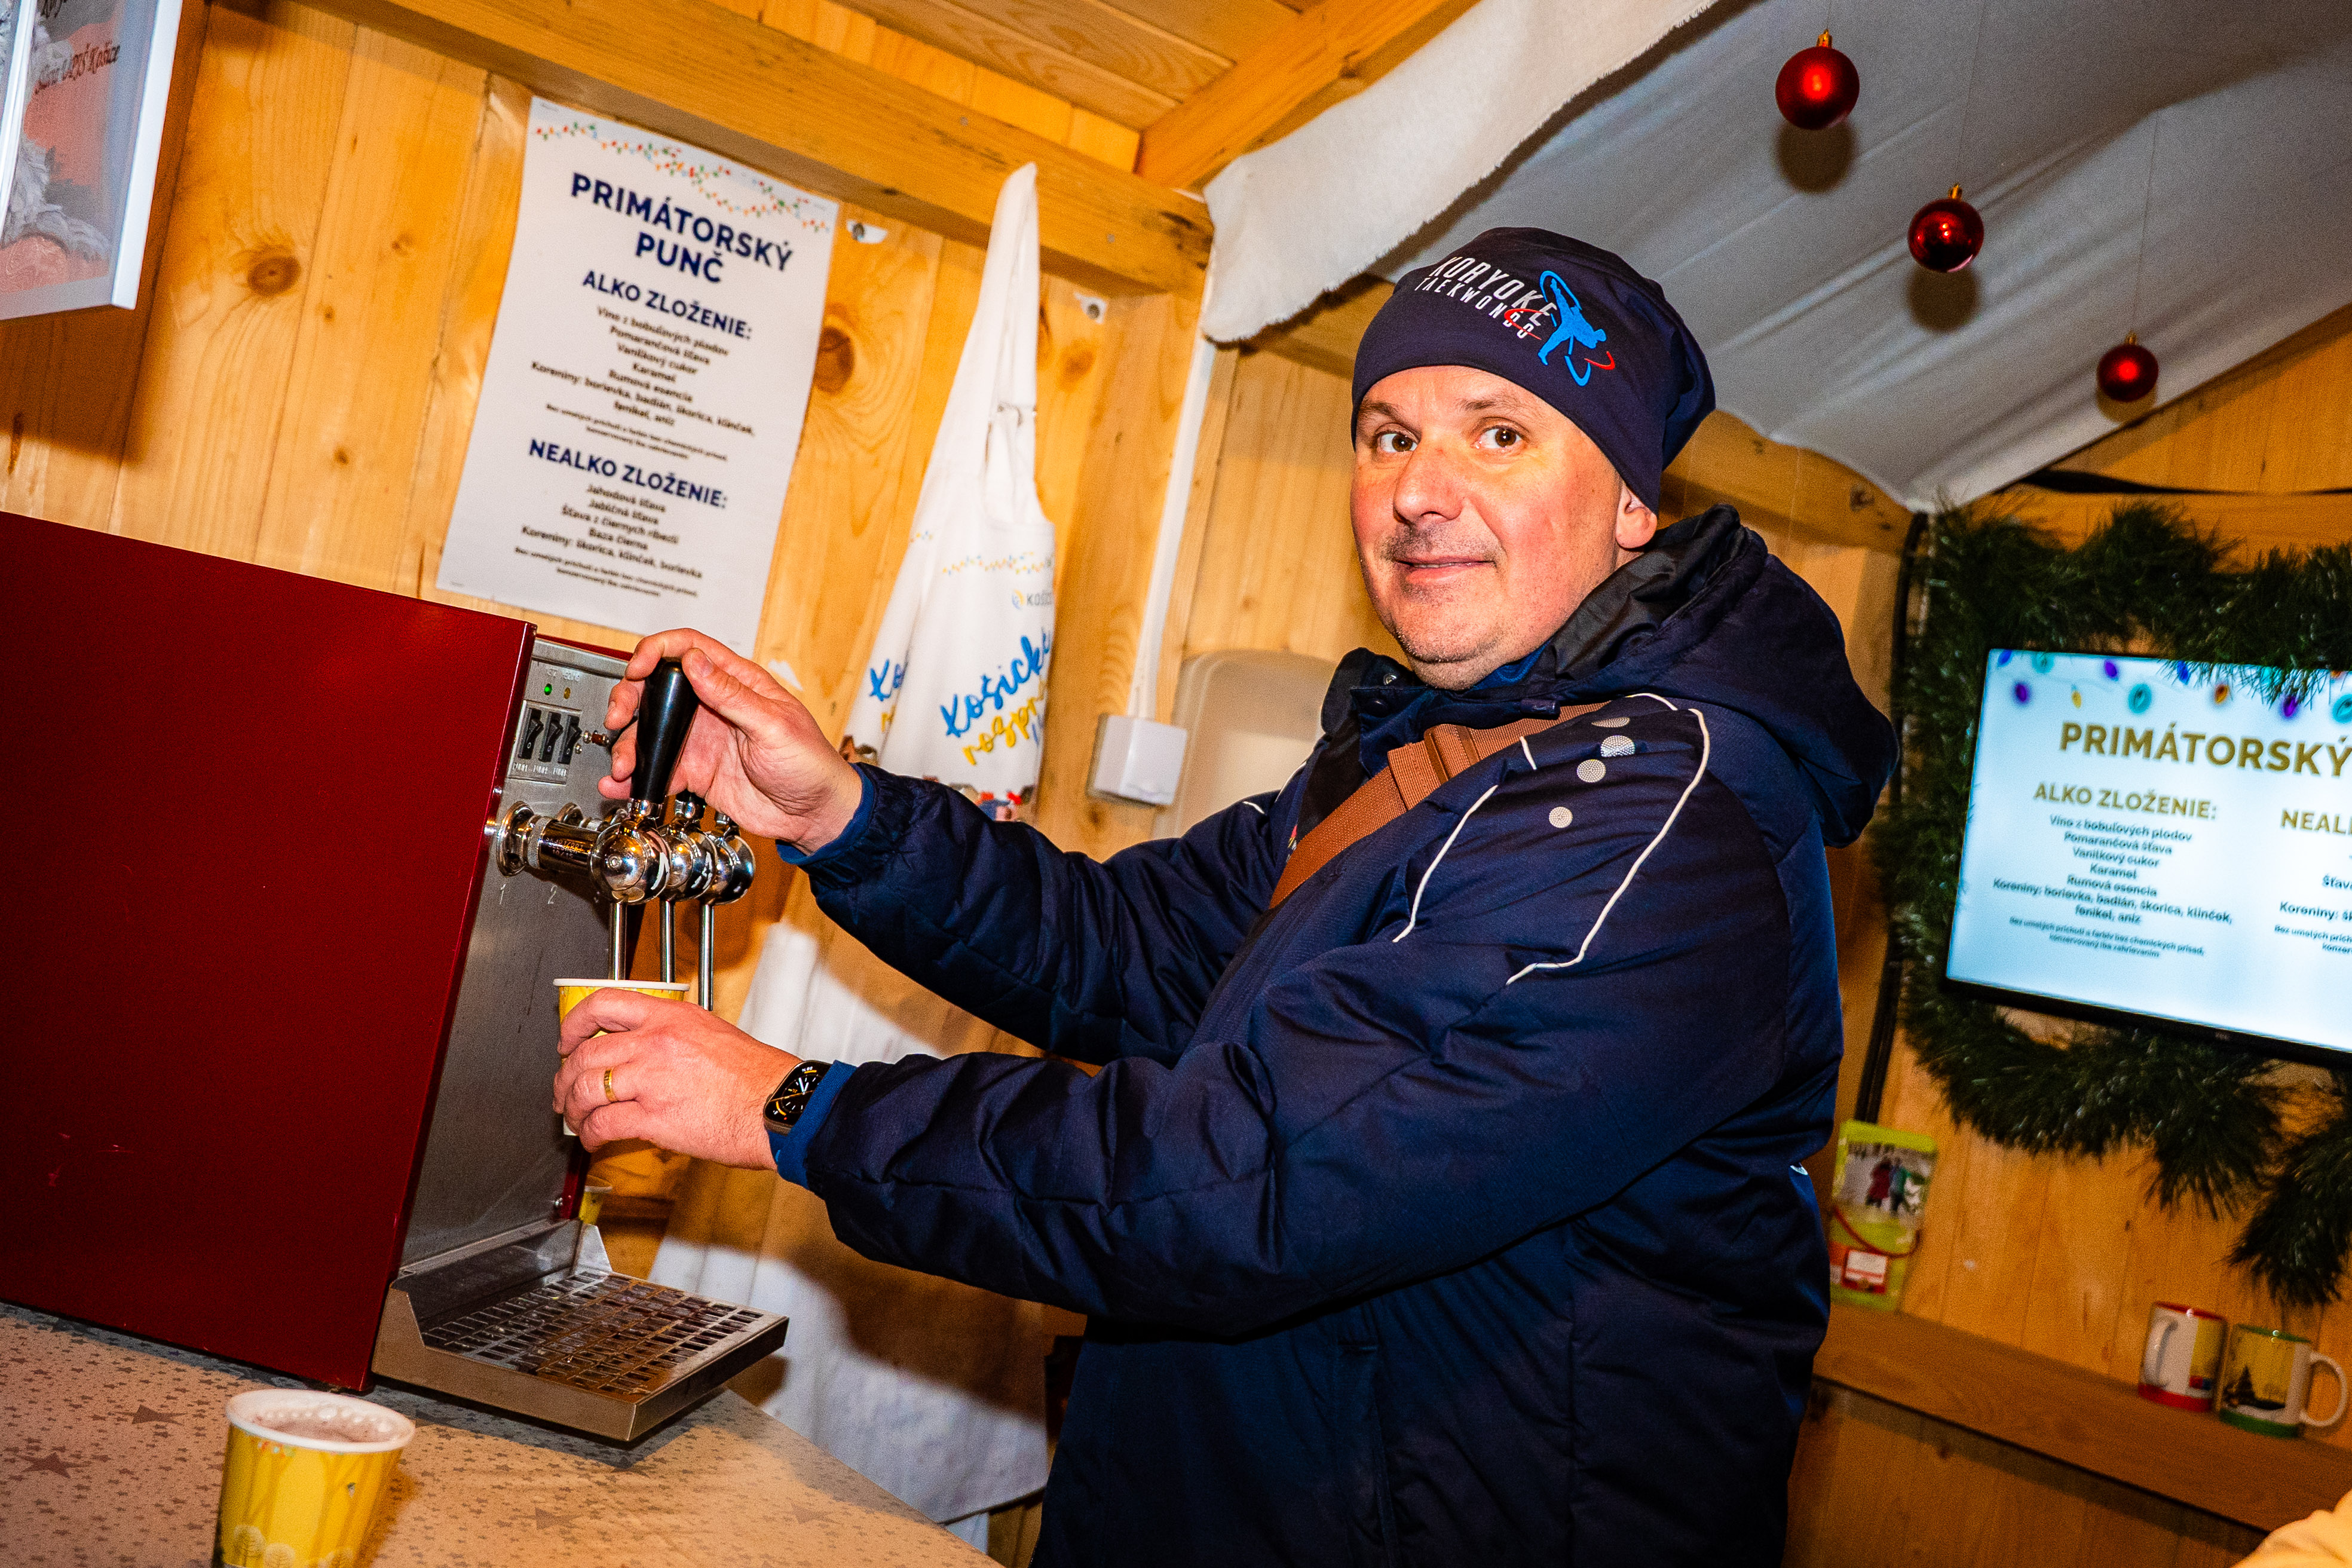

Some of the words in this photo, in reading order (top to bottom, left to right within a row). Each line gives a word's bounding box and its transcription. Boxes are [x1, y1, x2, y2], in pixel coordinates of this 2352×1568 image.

[571, 172, 792, 271] PRIMÁTORSKÝ
[635, 232, 722, 283] PUNČ
[583, 270, 641, 302] ALKO
[645, 290, 751, 339] ZLOŽENIE:
[1414, 277, 1535, 339] TAEKWONDO
[1429, 256, 1557, 326] KORYOKE
[529, 439, 617, 477] NEALKO
[621, 464, 726, 507] ZLOŽENIE:
[2059, 722, 2352, 779] PRIMÁTORSKÝ
[2032, 782, 2093, 806] ALKO
[2096, 788, 2216, 820] ZLOŽENIE:
[547, 884, 558, 905] 2
